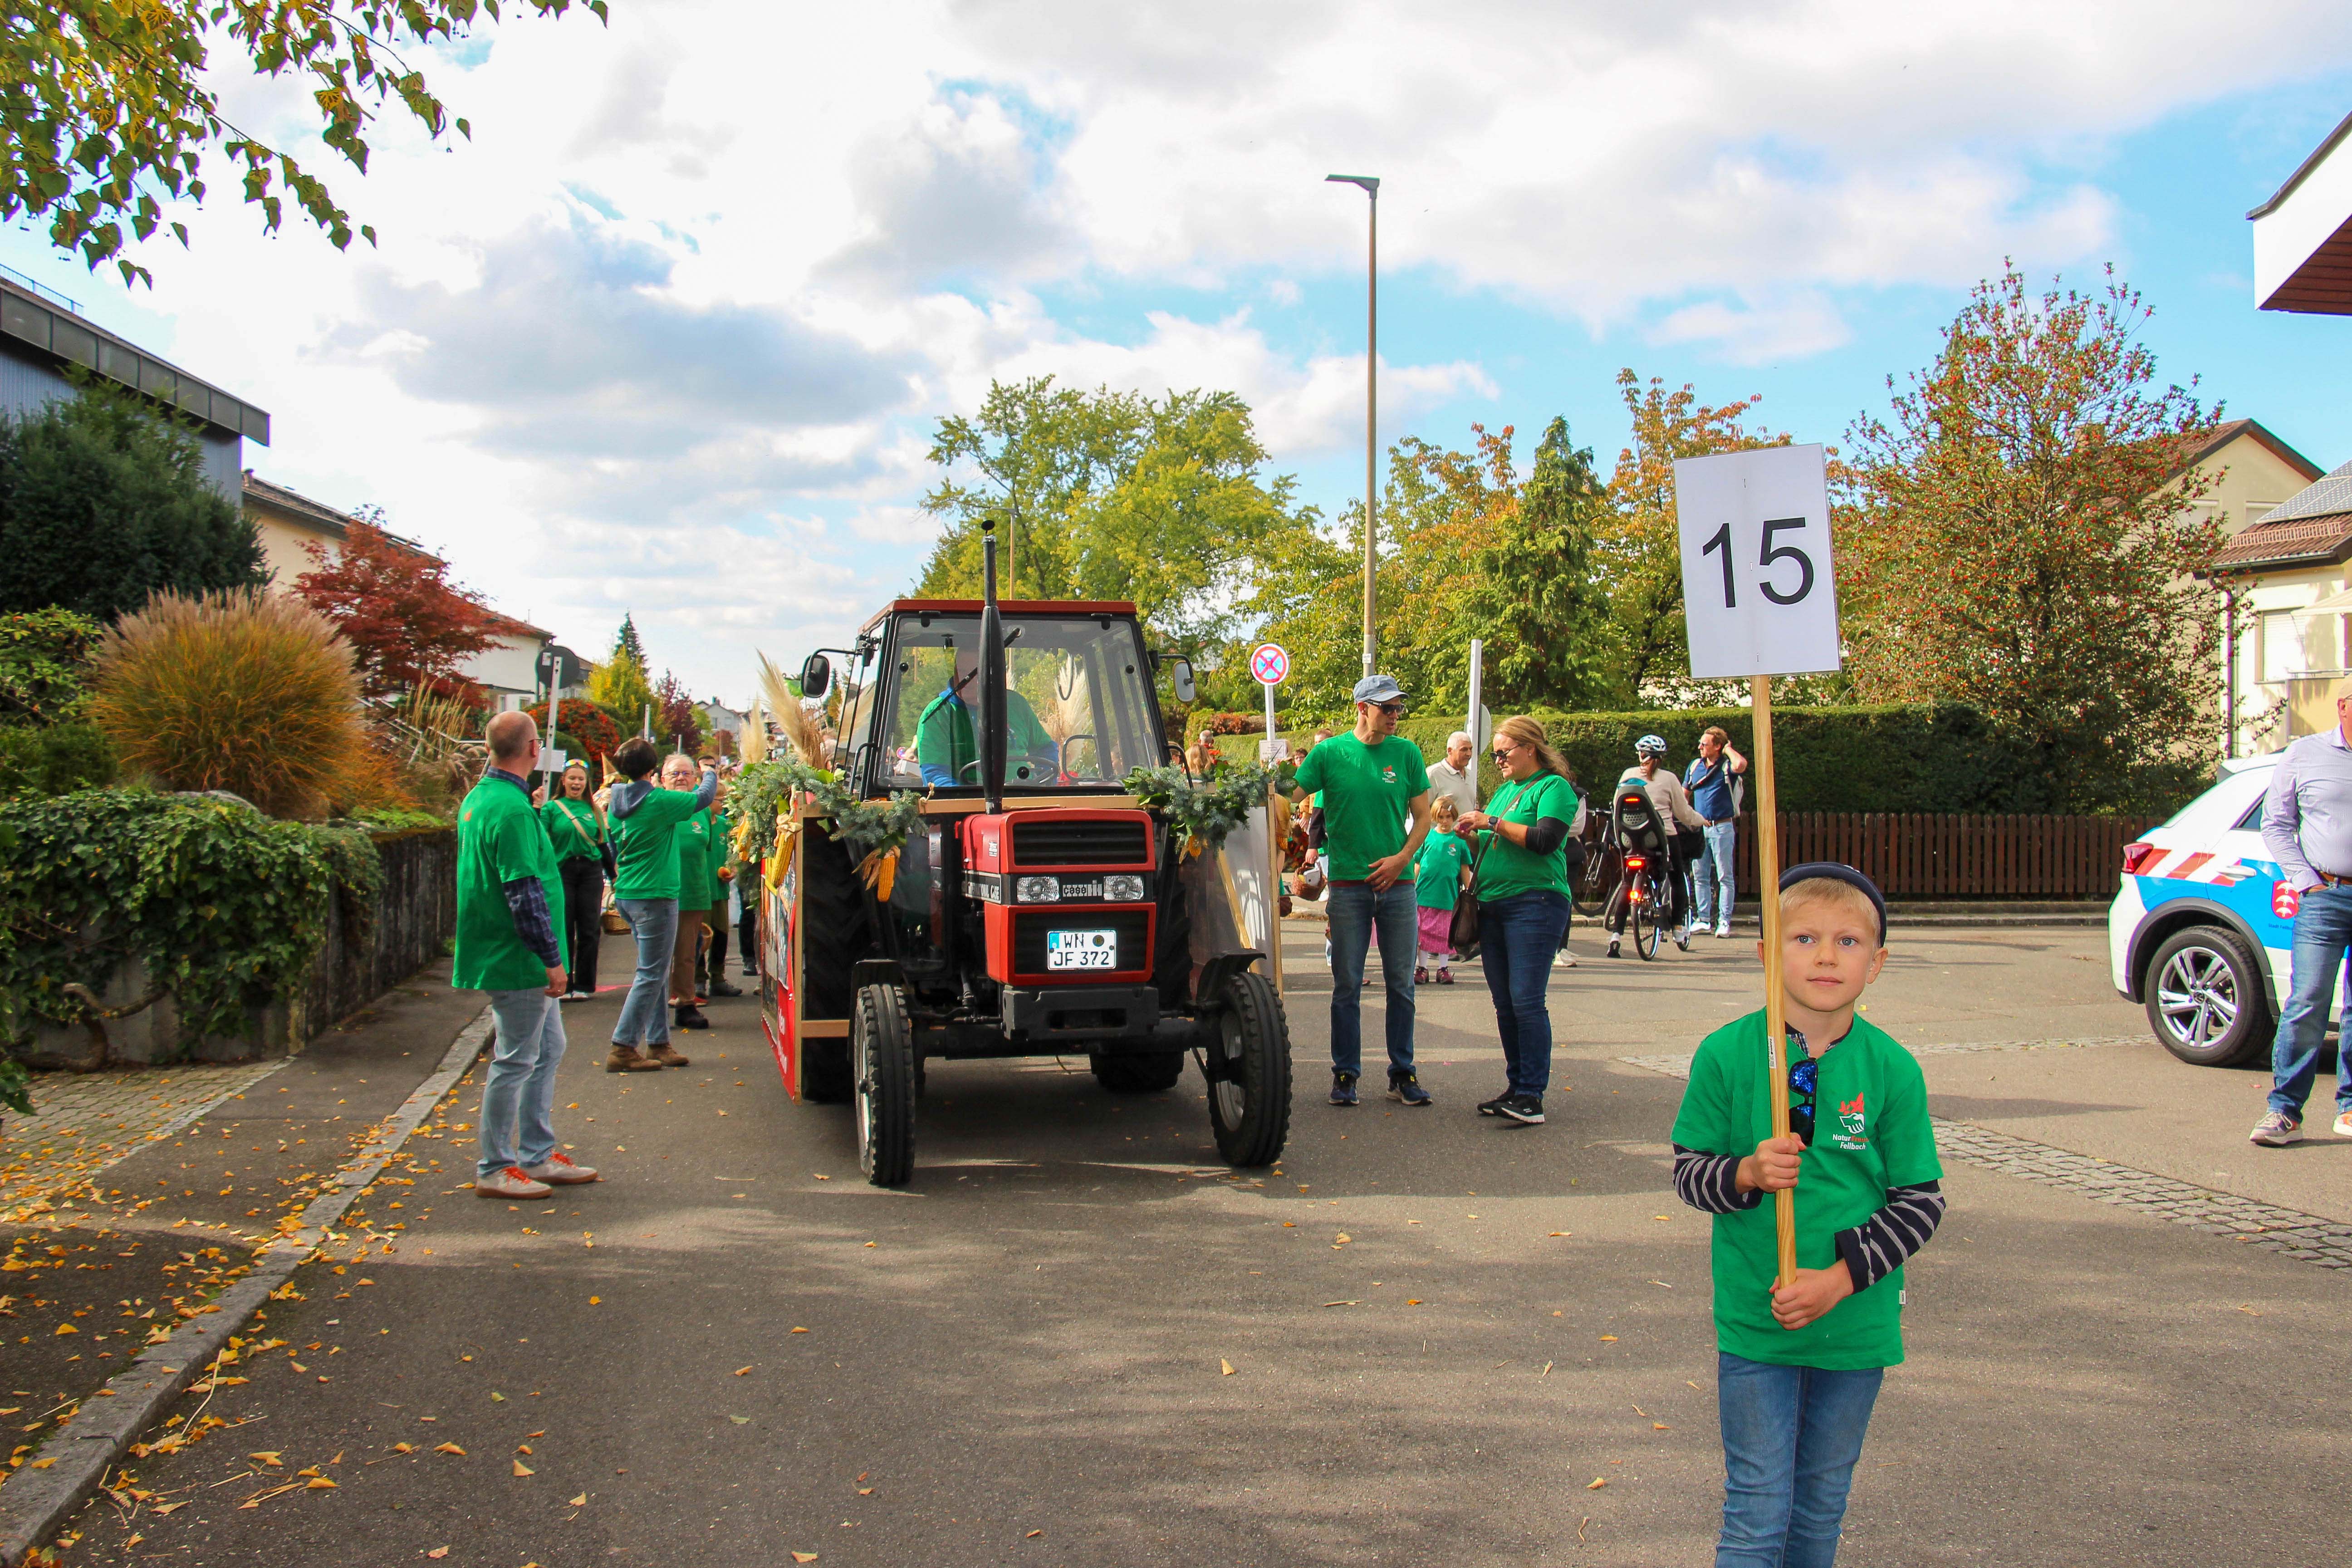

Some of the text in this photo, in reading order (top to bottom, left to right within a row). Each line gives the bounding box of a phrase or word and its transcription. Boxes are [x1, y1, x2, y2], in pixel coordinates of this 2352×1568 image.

[1702, 517, 1814, 608] 15
[1064, 934, 1084, 948] WN
[1054, 951, 1109, 966] JF 372
[1840, 1142, 1866, 1150] Fellbach
